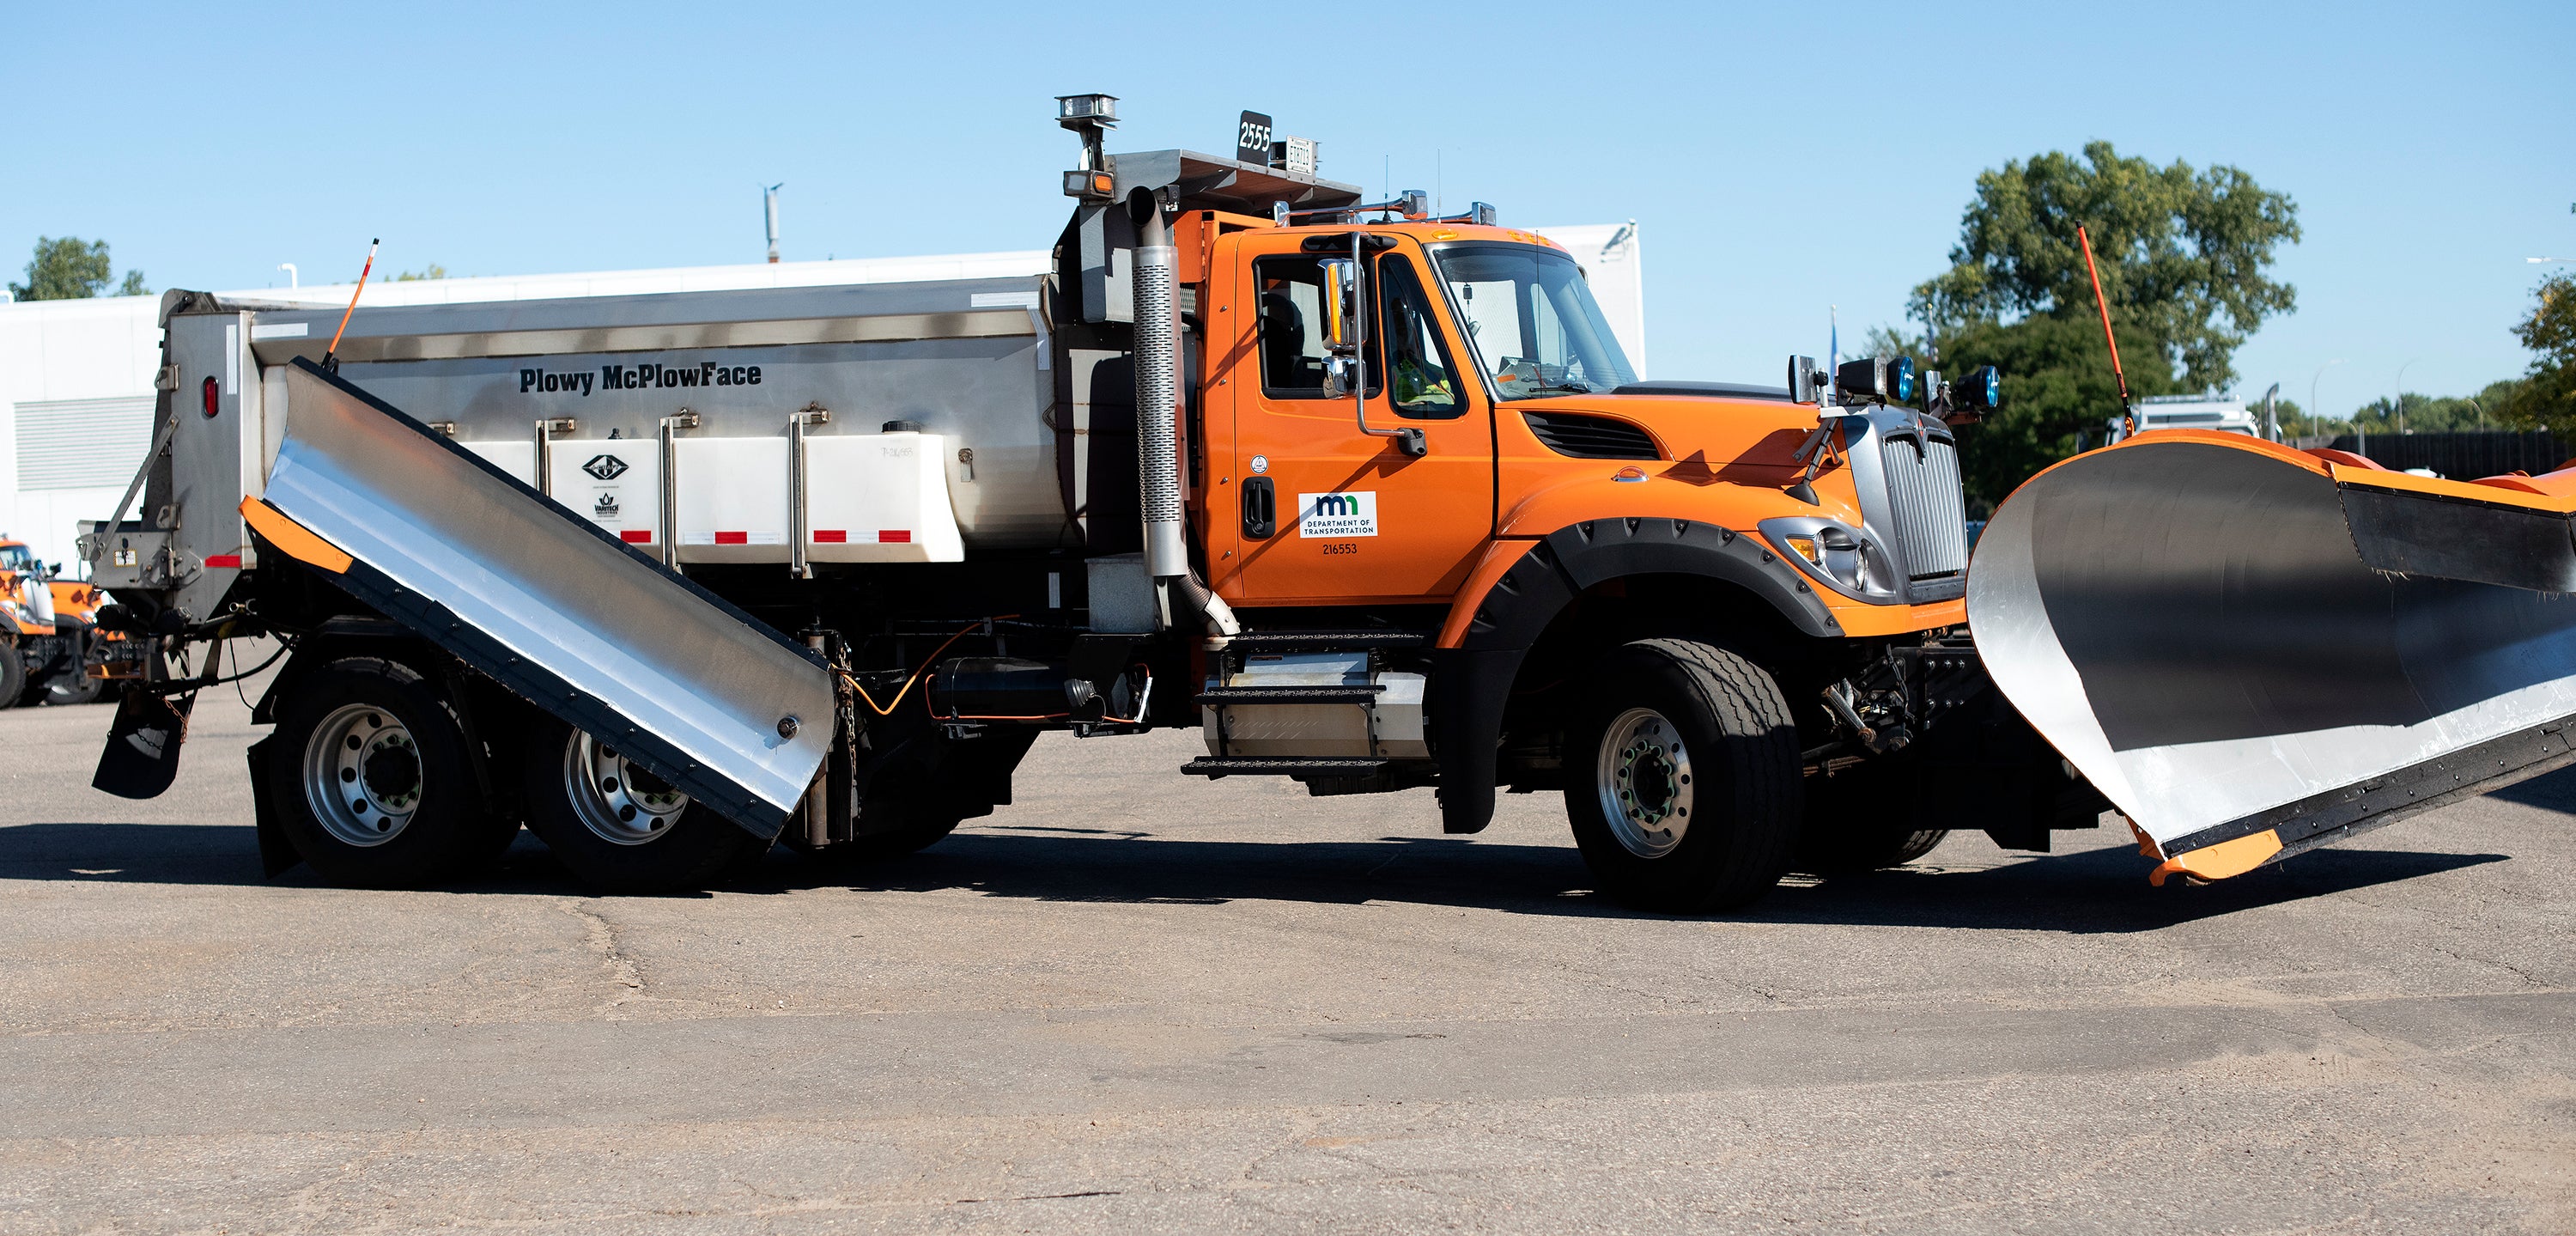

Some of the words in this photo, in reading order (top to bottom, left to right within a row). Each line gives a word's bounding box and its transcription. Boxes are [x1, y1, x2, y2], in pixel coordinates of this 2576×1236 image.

[1239, 121, 1271, 152] 2555
[519, 367, 594, 396] Plowy
[602, 362, 762, 390] McPlowFace
[1304, 527, 1374, 535] TRANSPORTATION
[1322, 543, 1358, 555] 216553
